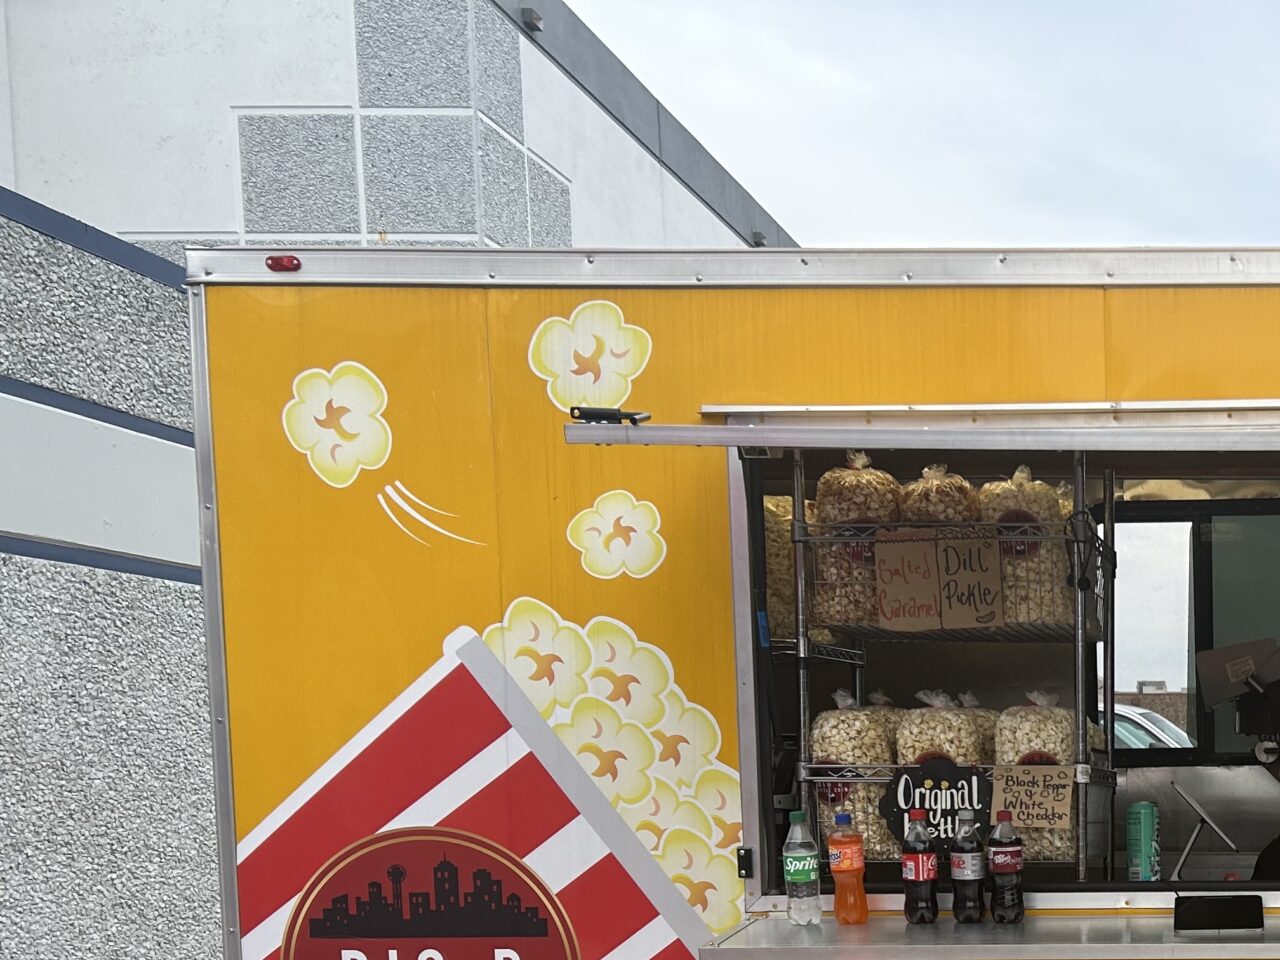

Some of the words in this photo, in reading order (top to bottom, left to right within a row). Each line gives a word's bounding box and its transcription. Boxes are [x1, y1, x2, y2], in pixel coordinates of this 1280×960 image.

[878, 551, 931, 585] Salted
[943, 545, 988, 576] Dill
[879, 589, 940, 620] Caramel
[943, 579, 999, 613] Pickle
[1005, 775, 1039, 788] Black
[897, 774, 983, 824] Original
[1004, 797, 1045, 810] White
